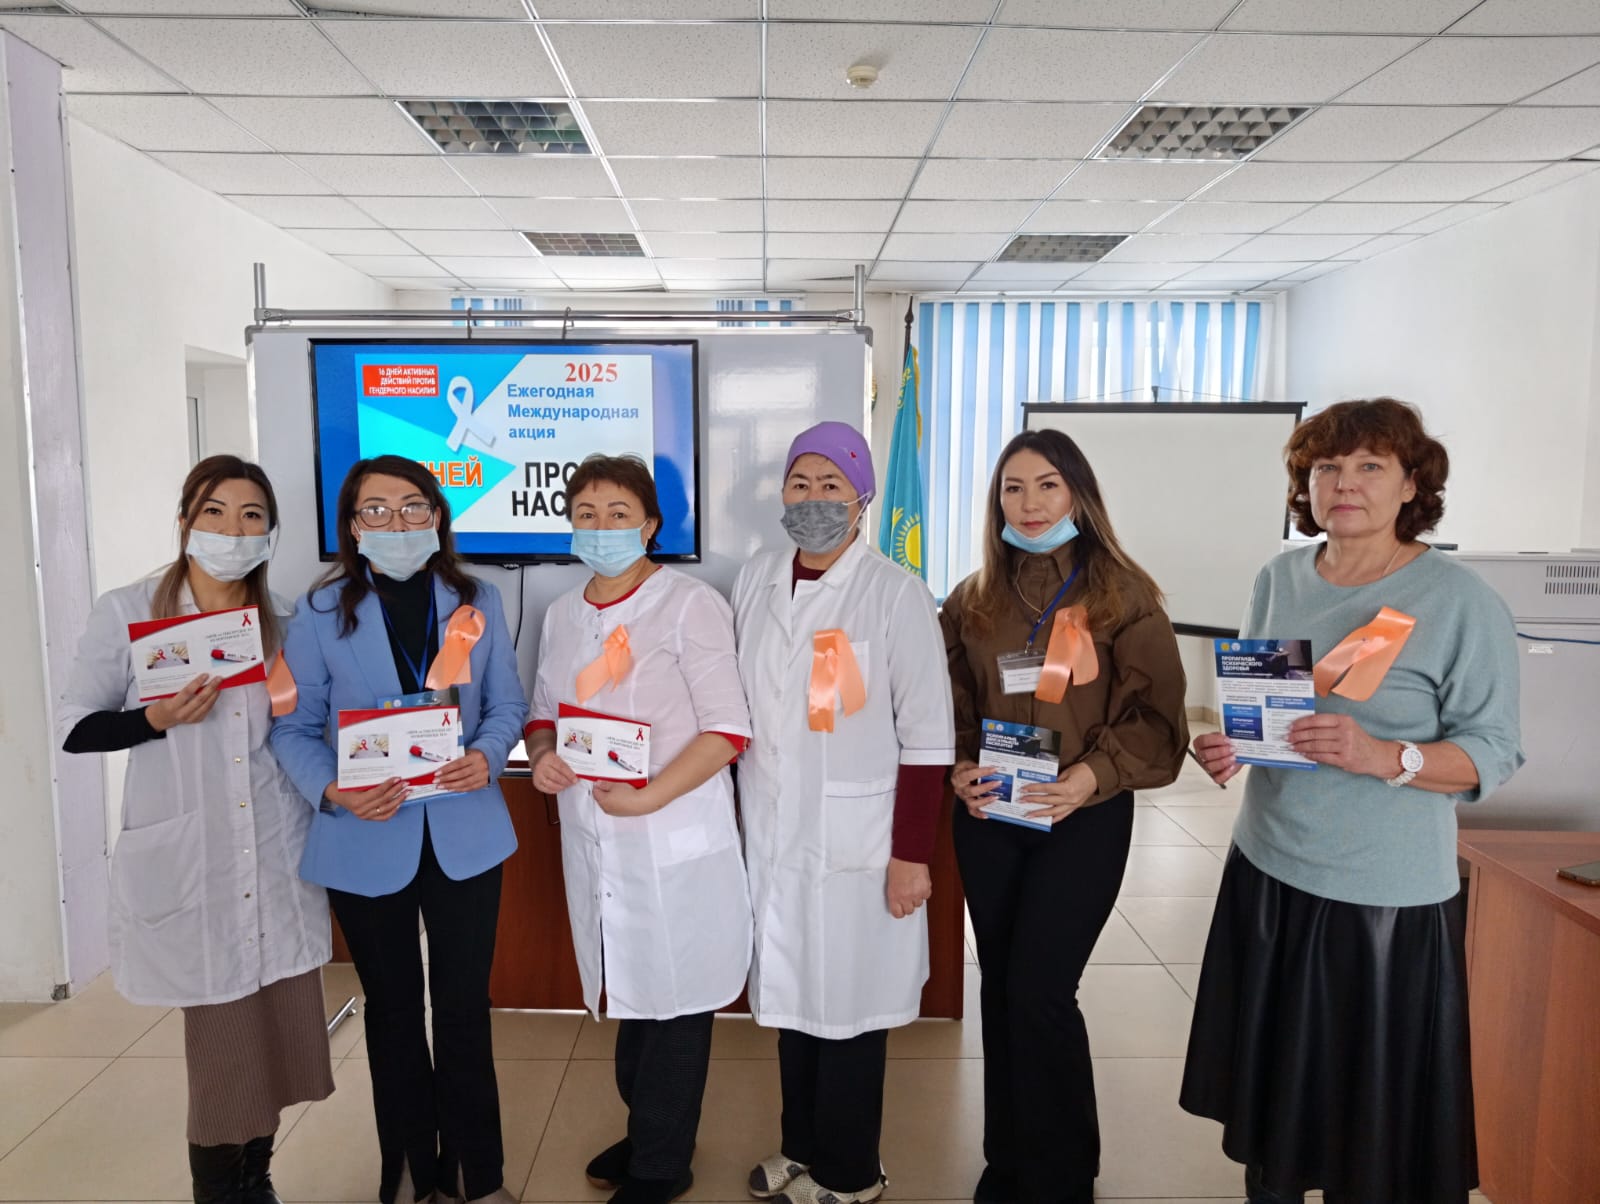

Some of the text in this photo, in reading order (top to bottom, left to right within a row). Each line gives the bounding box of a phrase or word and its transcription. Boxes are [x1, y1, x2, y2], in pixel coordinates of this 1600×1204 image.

[386, 366, 402, 376] ДНЕЙ
[403, 367, 435, 376] АКТИВНЫХ
[565, 362, 618, 383] 2025
[381, 375, 436, 386] ДЕЙСТВИЙ ПРОТИВ
[369, 386, 436, 395] ГЕНДЕРНОГО НАСИЛИЯ
[507, 383, 595, 399] Ежегодная
[507, 403, 639, 421] Международная
[508, 427, 556, 440] акция
[418, 455, 483, 487] НЕЙ
